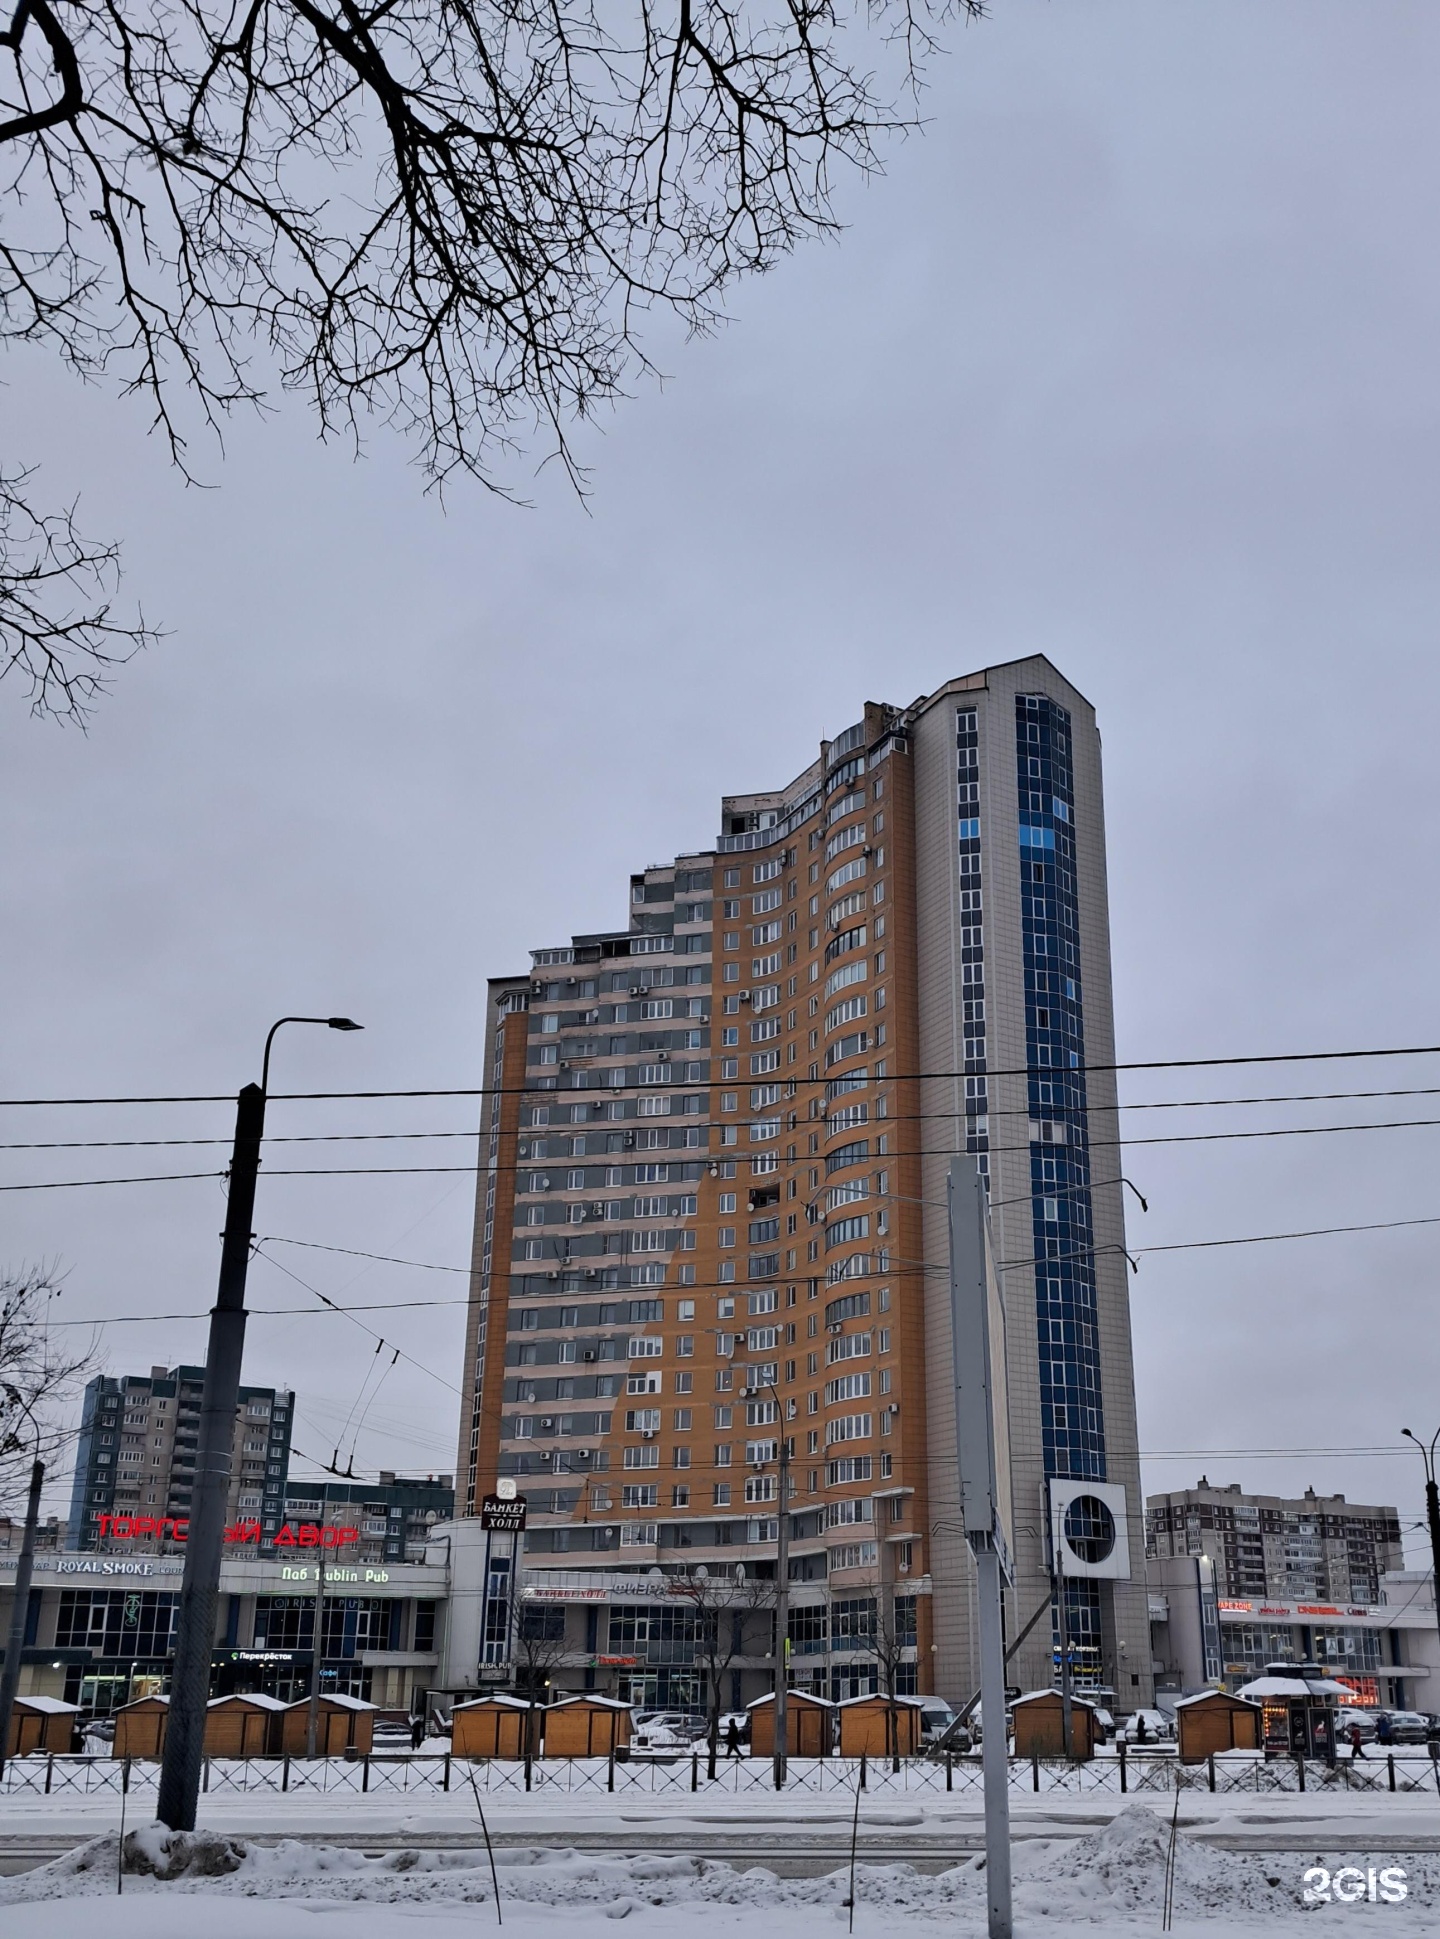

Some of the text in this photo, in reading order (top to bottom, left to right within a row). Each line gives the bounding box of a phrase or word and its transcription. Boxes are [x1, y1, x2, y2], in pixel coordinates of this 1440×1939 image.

[483, 1501, 527, 1514] БАНКЕТ
[487, 1518, 520, 1529] ХОЛЛ
[97, 1515, 358, 1547] ТОРГОЫЙ ДВОР
[56, 1560, 154, 1576] ROYAL SMOKE
[159, 1562, 184, 1574] LOUN
[281, 1567, 308, 1580] Паб
[365, 1569, 389, 1583] Pub
[239, 1652, 293, 1661] Перекрёсток
